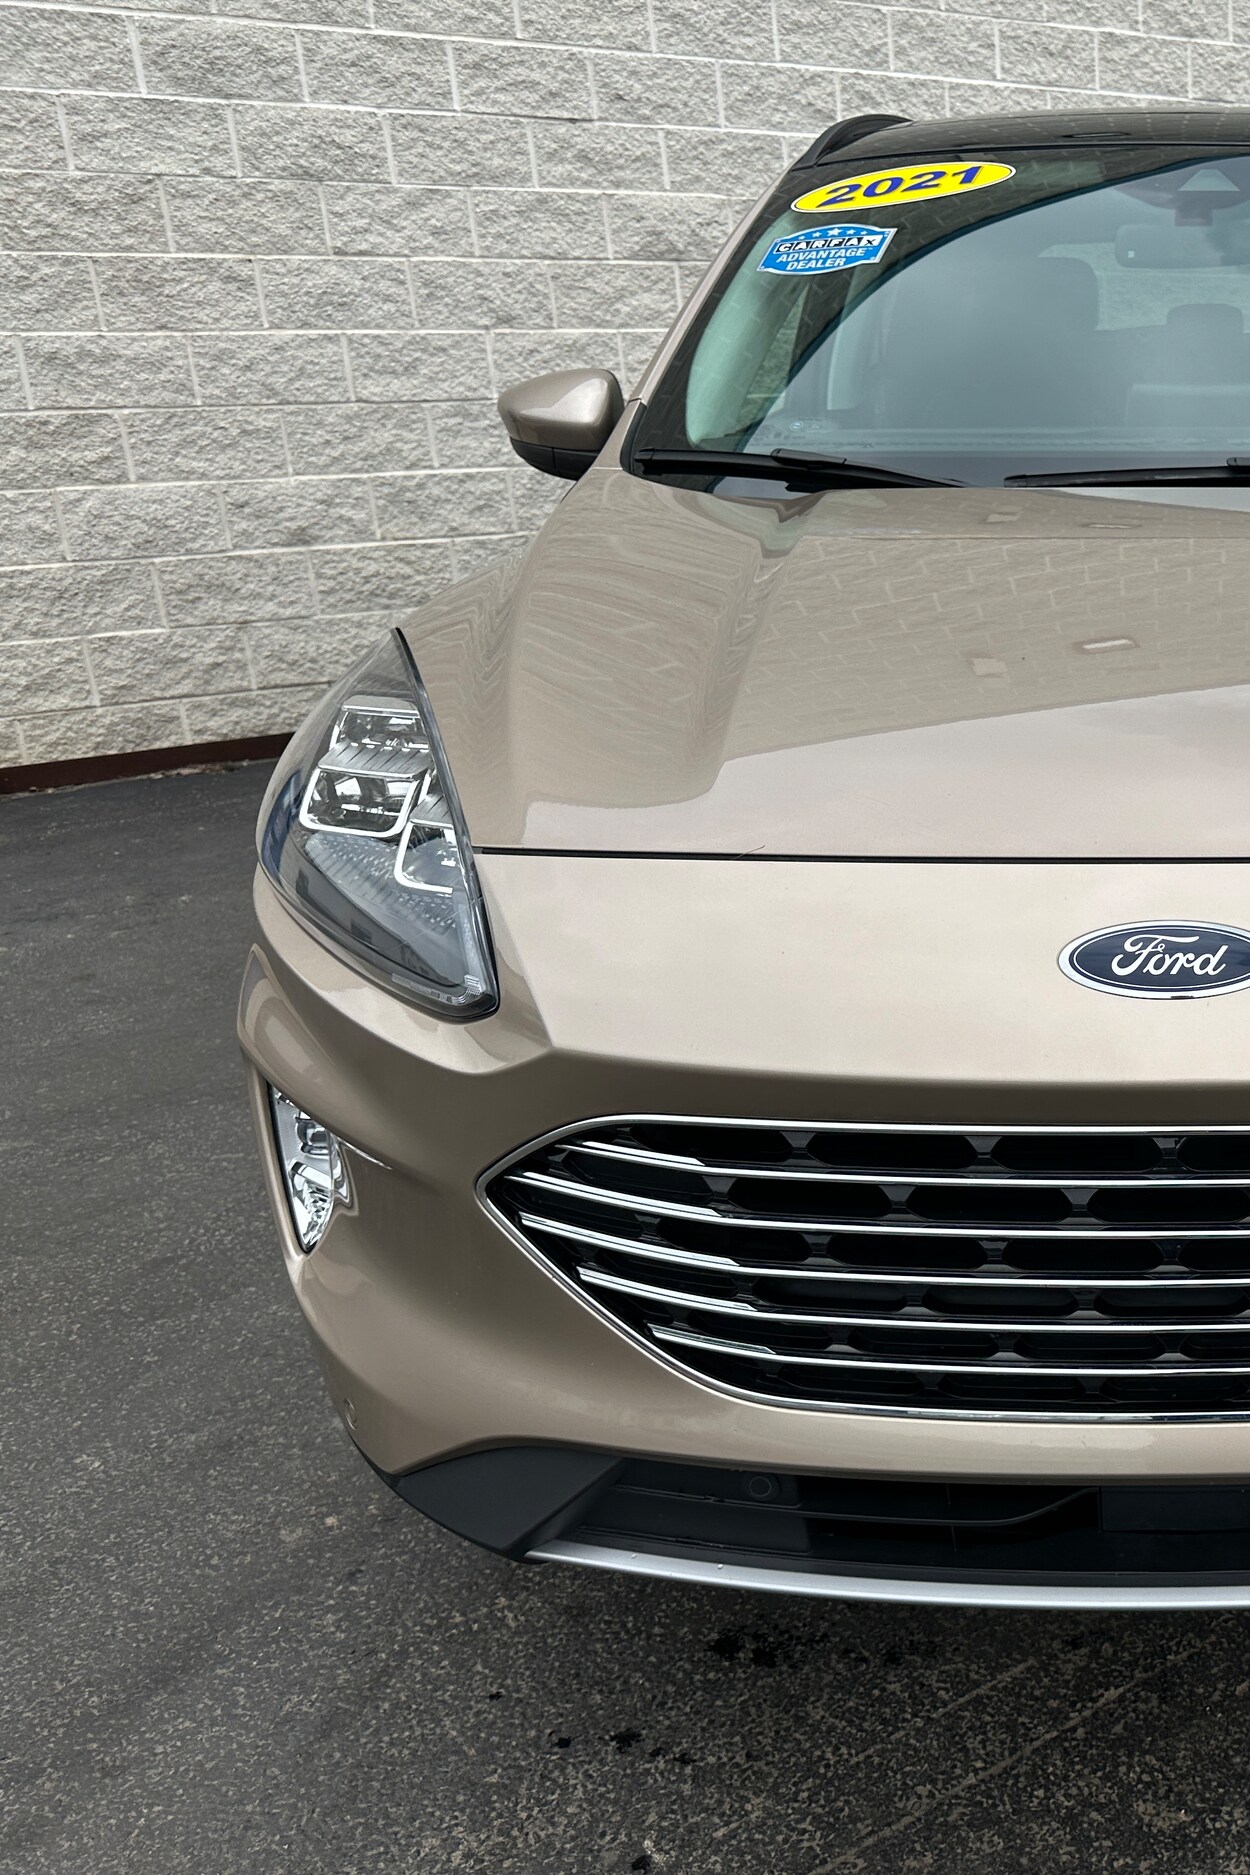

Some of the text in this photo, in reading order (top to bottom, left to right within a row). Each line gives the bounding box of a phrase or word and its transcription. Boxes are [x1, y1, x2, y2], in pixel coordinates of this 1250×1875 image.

[816, 165, 983, 208] 2021
[778, 236, 877, 253] CARFAX
[776, 248, 865, 263] ADVANTAGE
[786, 257, 846, 271] DEALER
[1111, 934, 1228, 976] Ford
